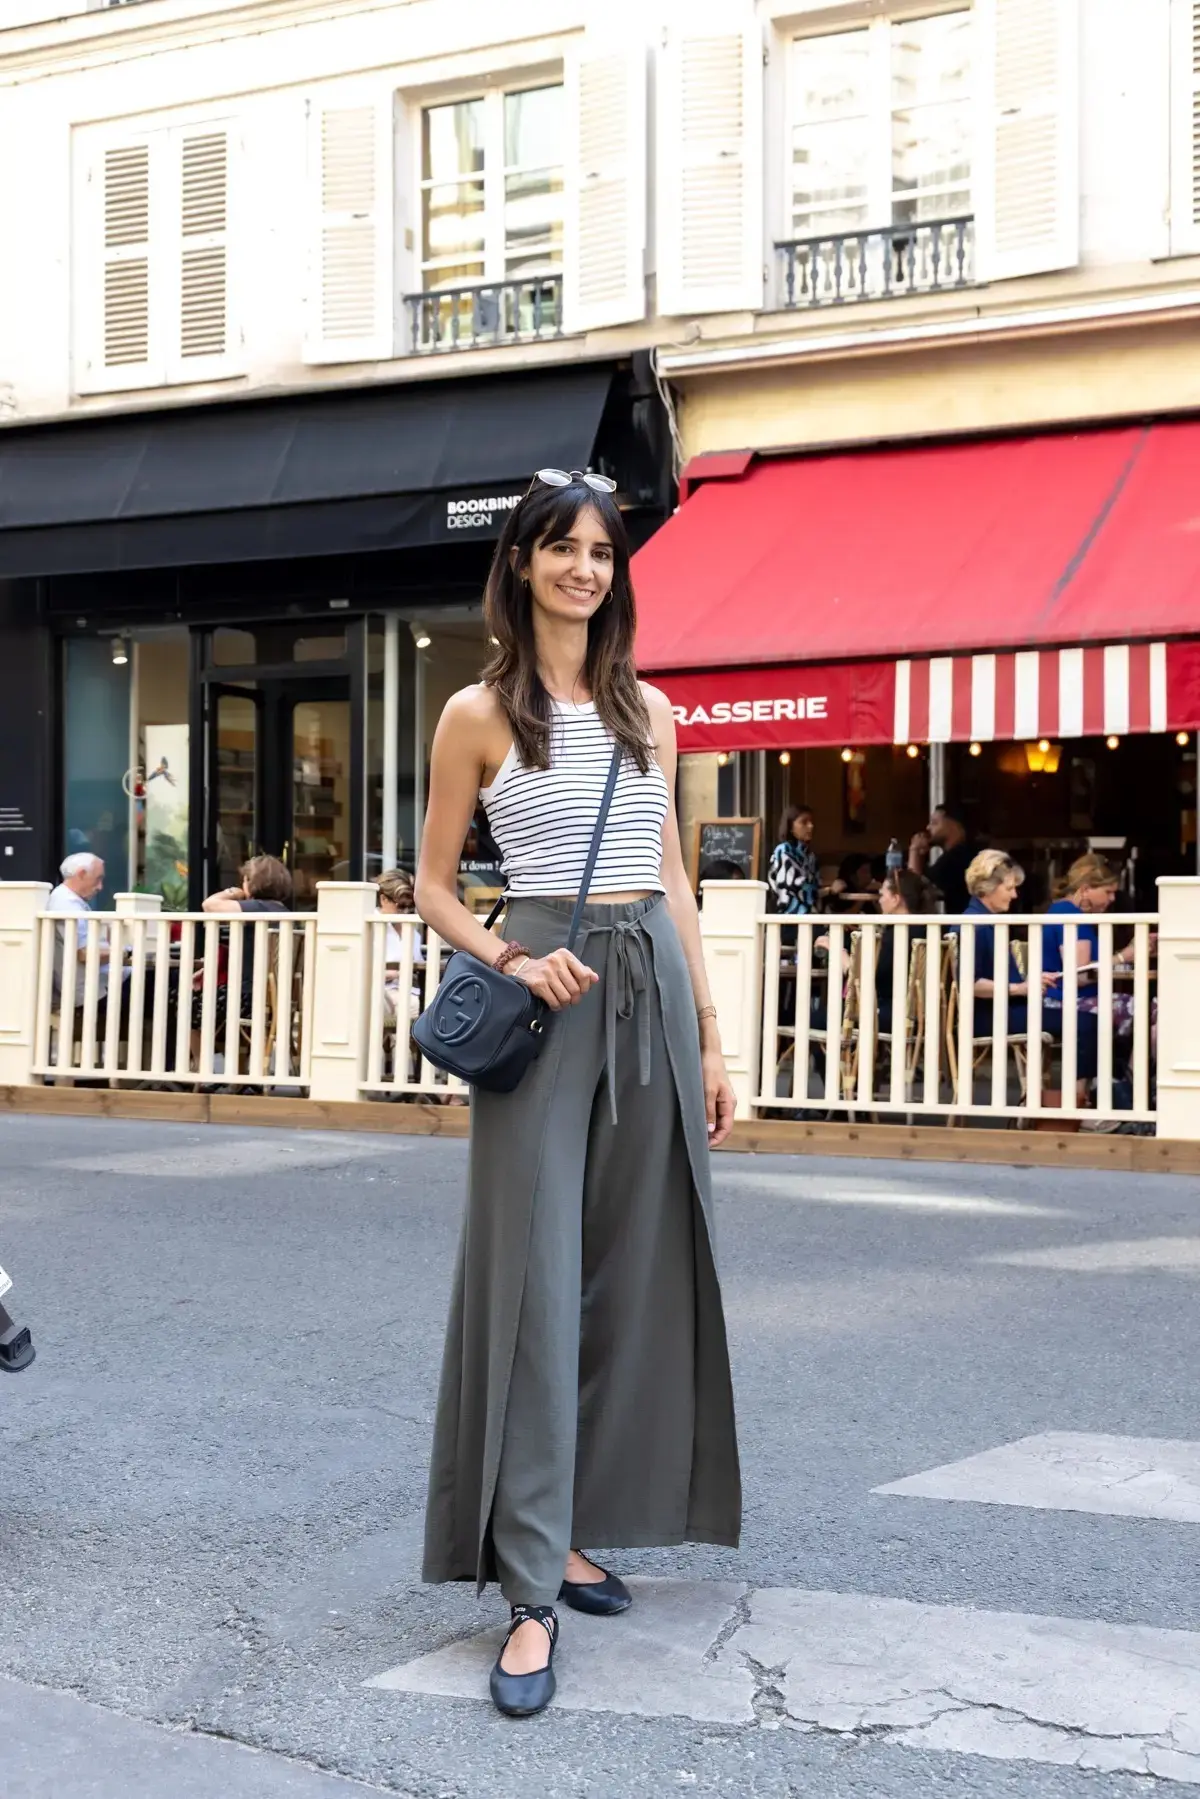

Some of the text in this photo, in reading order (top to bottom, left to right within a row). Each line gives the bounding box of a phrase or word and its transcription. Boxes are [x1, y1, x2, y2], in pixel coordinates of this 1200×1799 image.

[447, 495, 523, 515] BOOKBIND
[447, 513, 492, 529] DESIGN
[671, 697, 828, 726] RASSERIE
[469, 860, 493, 871] down
